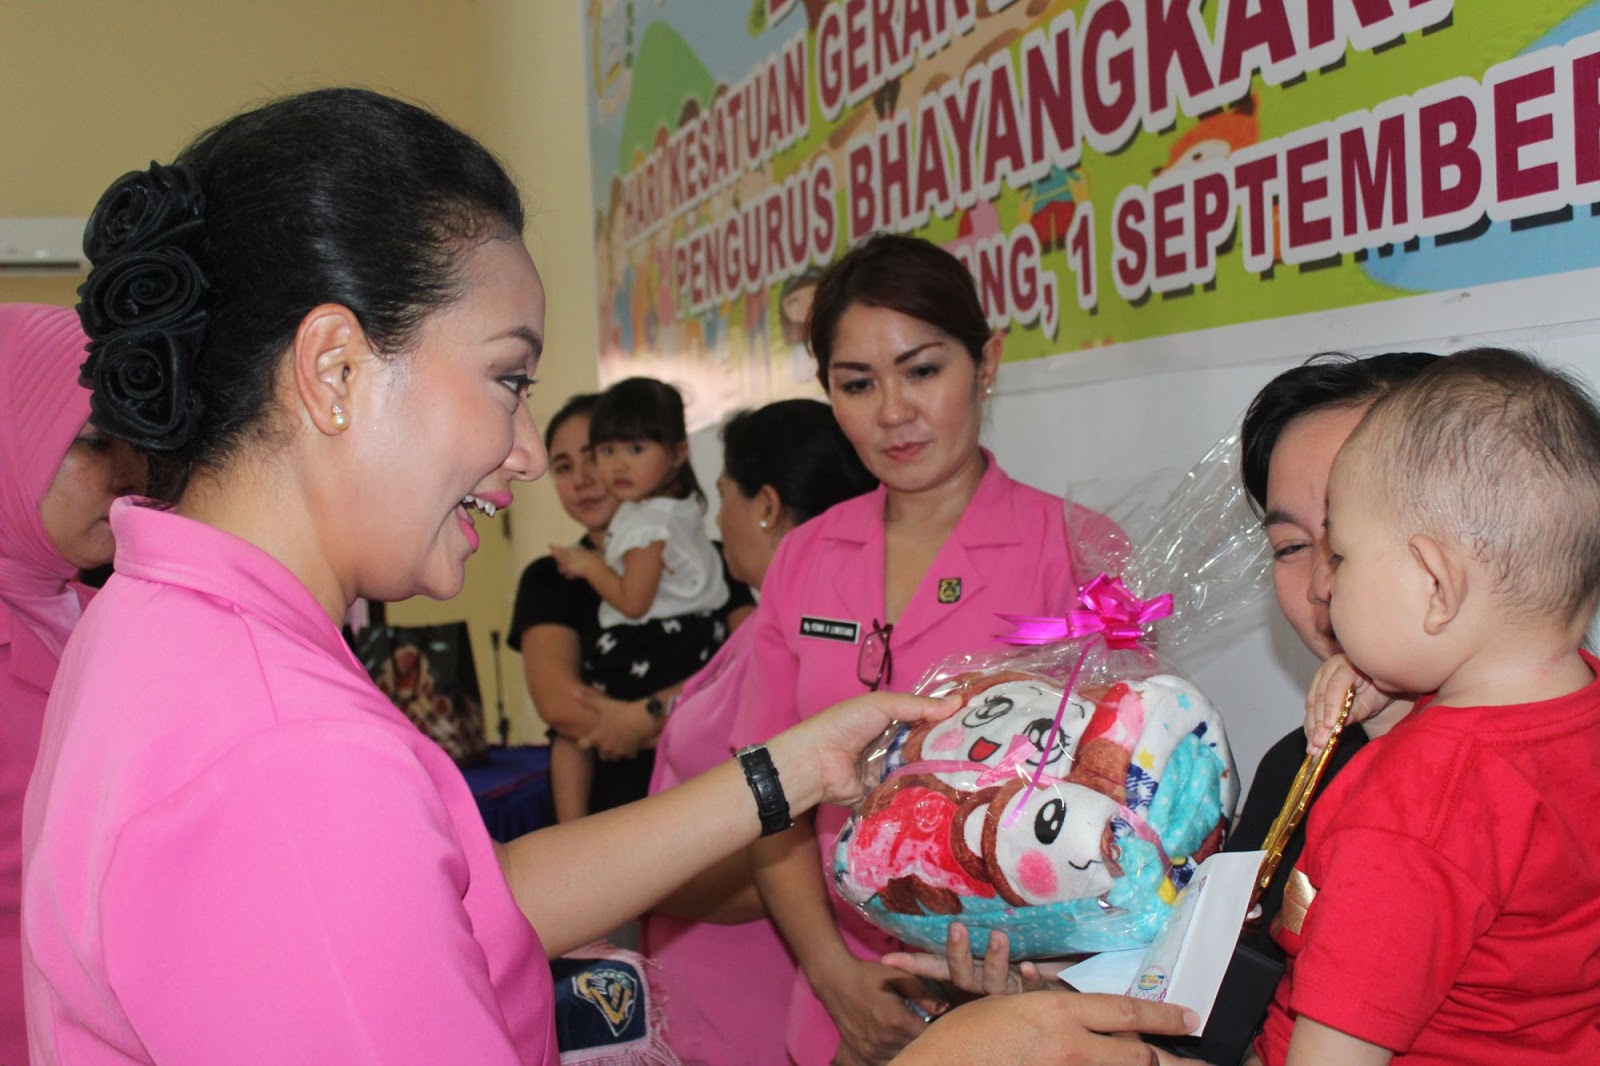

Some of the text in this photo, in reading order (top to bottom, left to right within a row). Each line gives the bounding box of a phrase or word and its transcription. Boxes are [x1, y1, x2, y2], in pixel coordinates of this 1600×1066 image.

[621, 150, 668, 242] HARI
[668, 40, 807, 208] KESATUAN
[673, 0, 1434, 312] PENGURUS BHAYANGKA
[1071, 213, 1093, 297] 1
